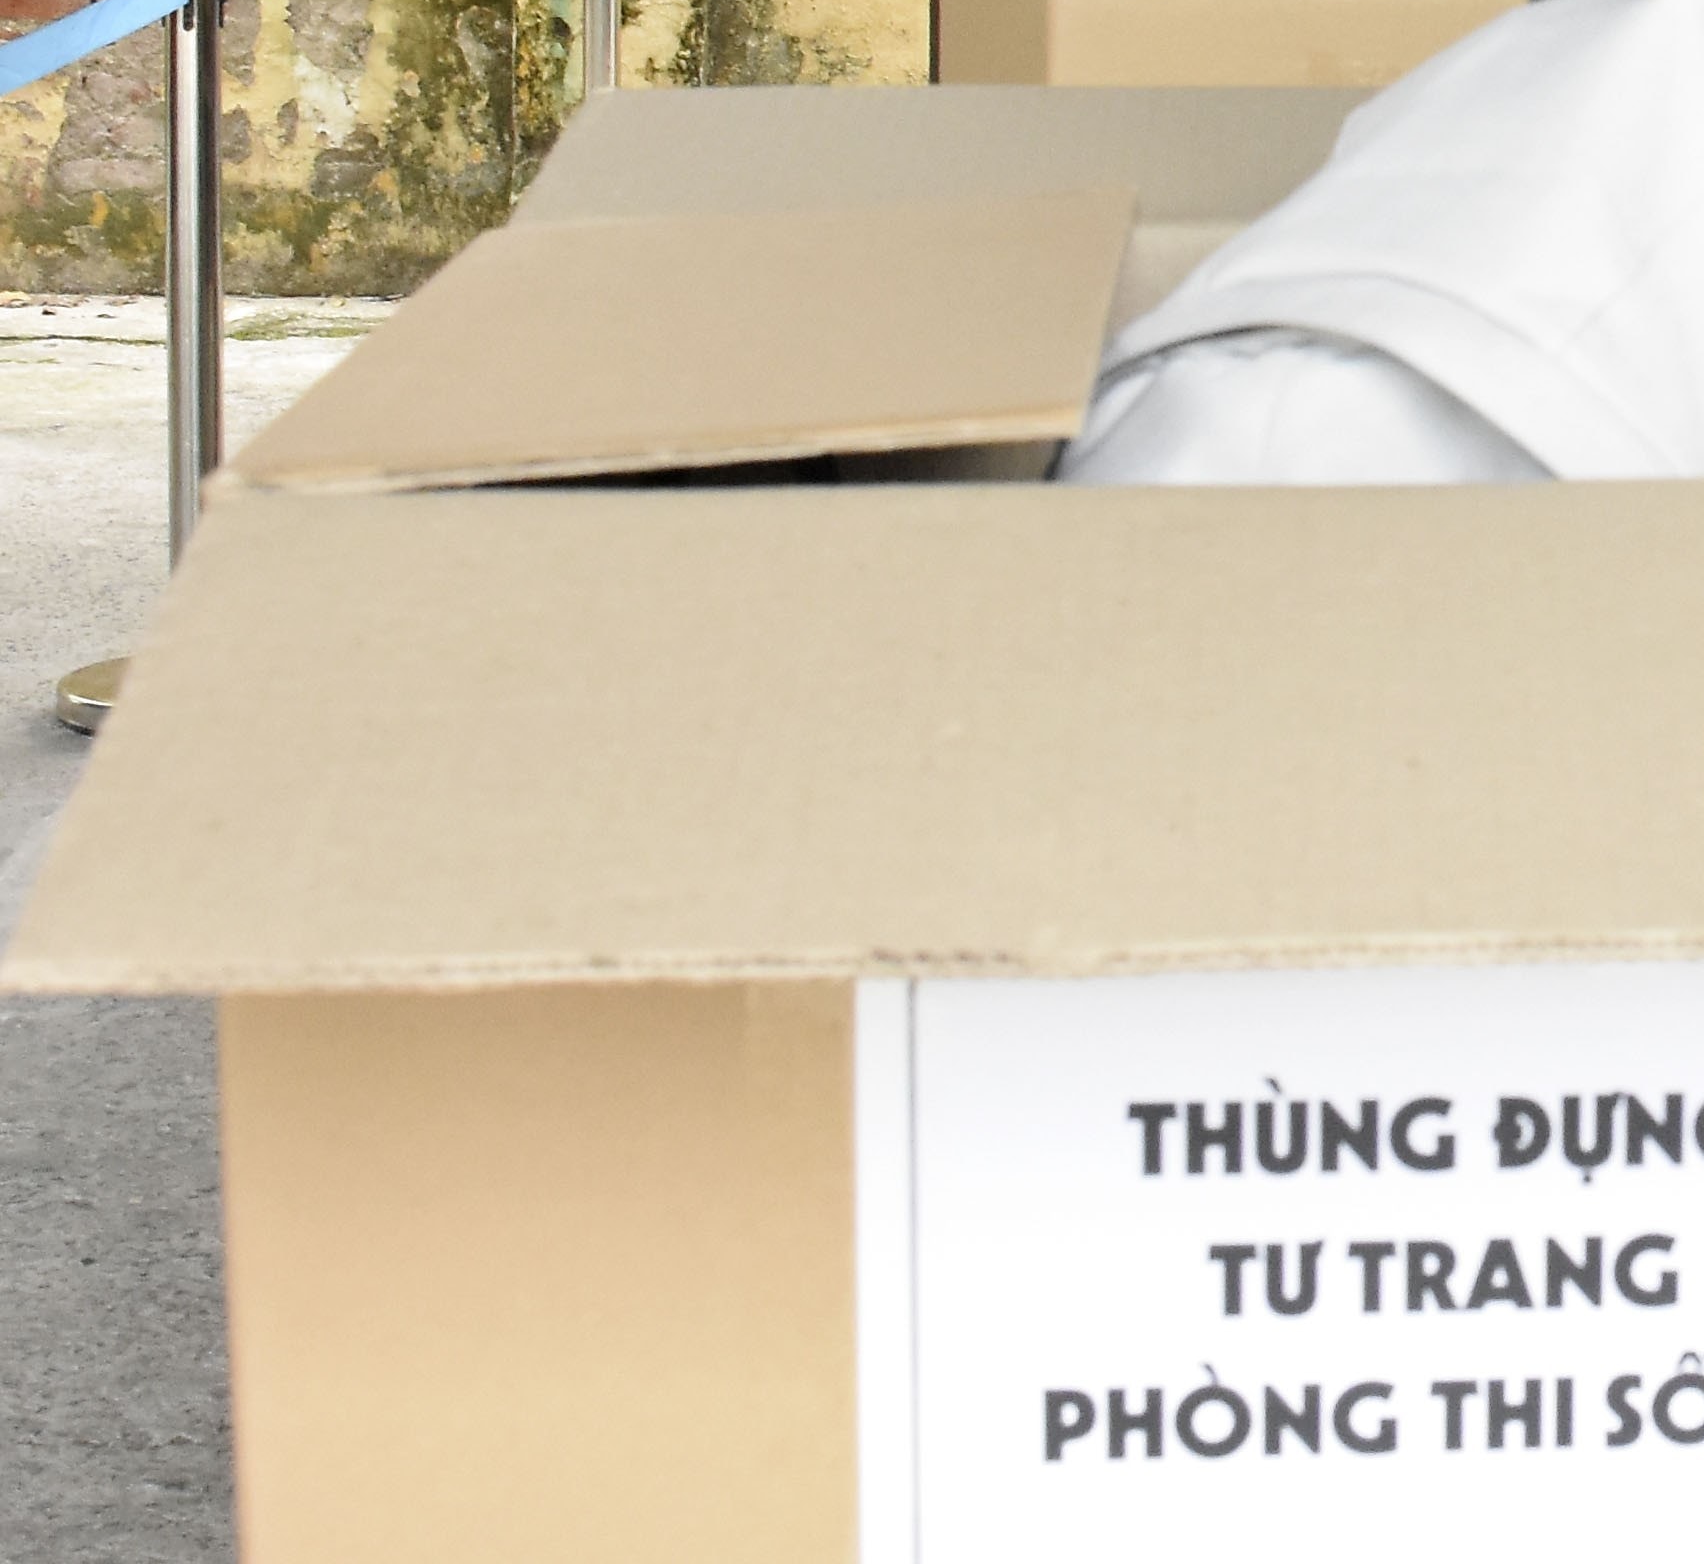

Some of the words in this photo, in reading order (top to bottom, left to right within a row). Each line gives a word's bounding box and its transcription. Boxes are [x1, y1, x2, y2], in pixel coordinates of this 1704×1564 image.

[1129, 1077, 1455, 1175] THÙNG
[1210, 1239, 1324, 1315] TƯ
[1349, 1233, 1678, 1313] TRANG
[1044, 1363, 1396, 1460] PHÒNG
[1432, 1378, 1573, 1449] THI
